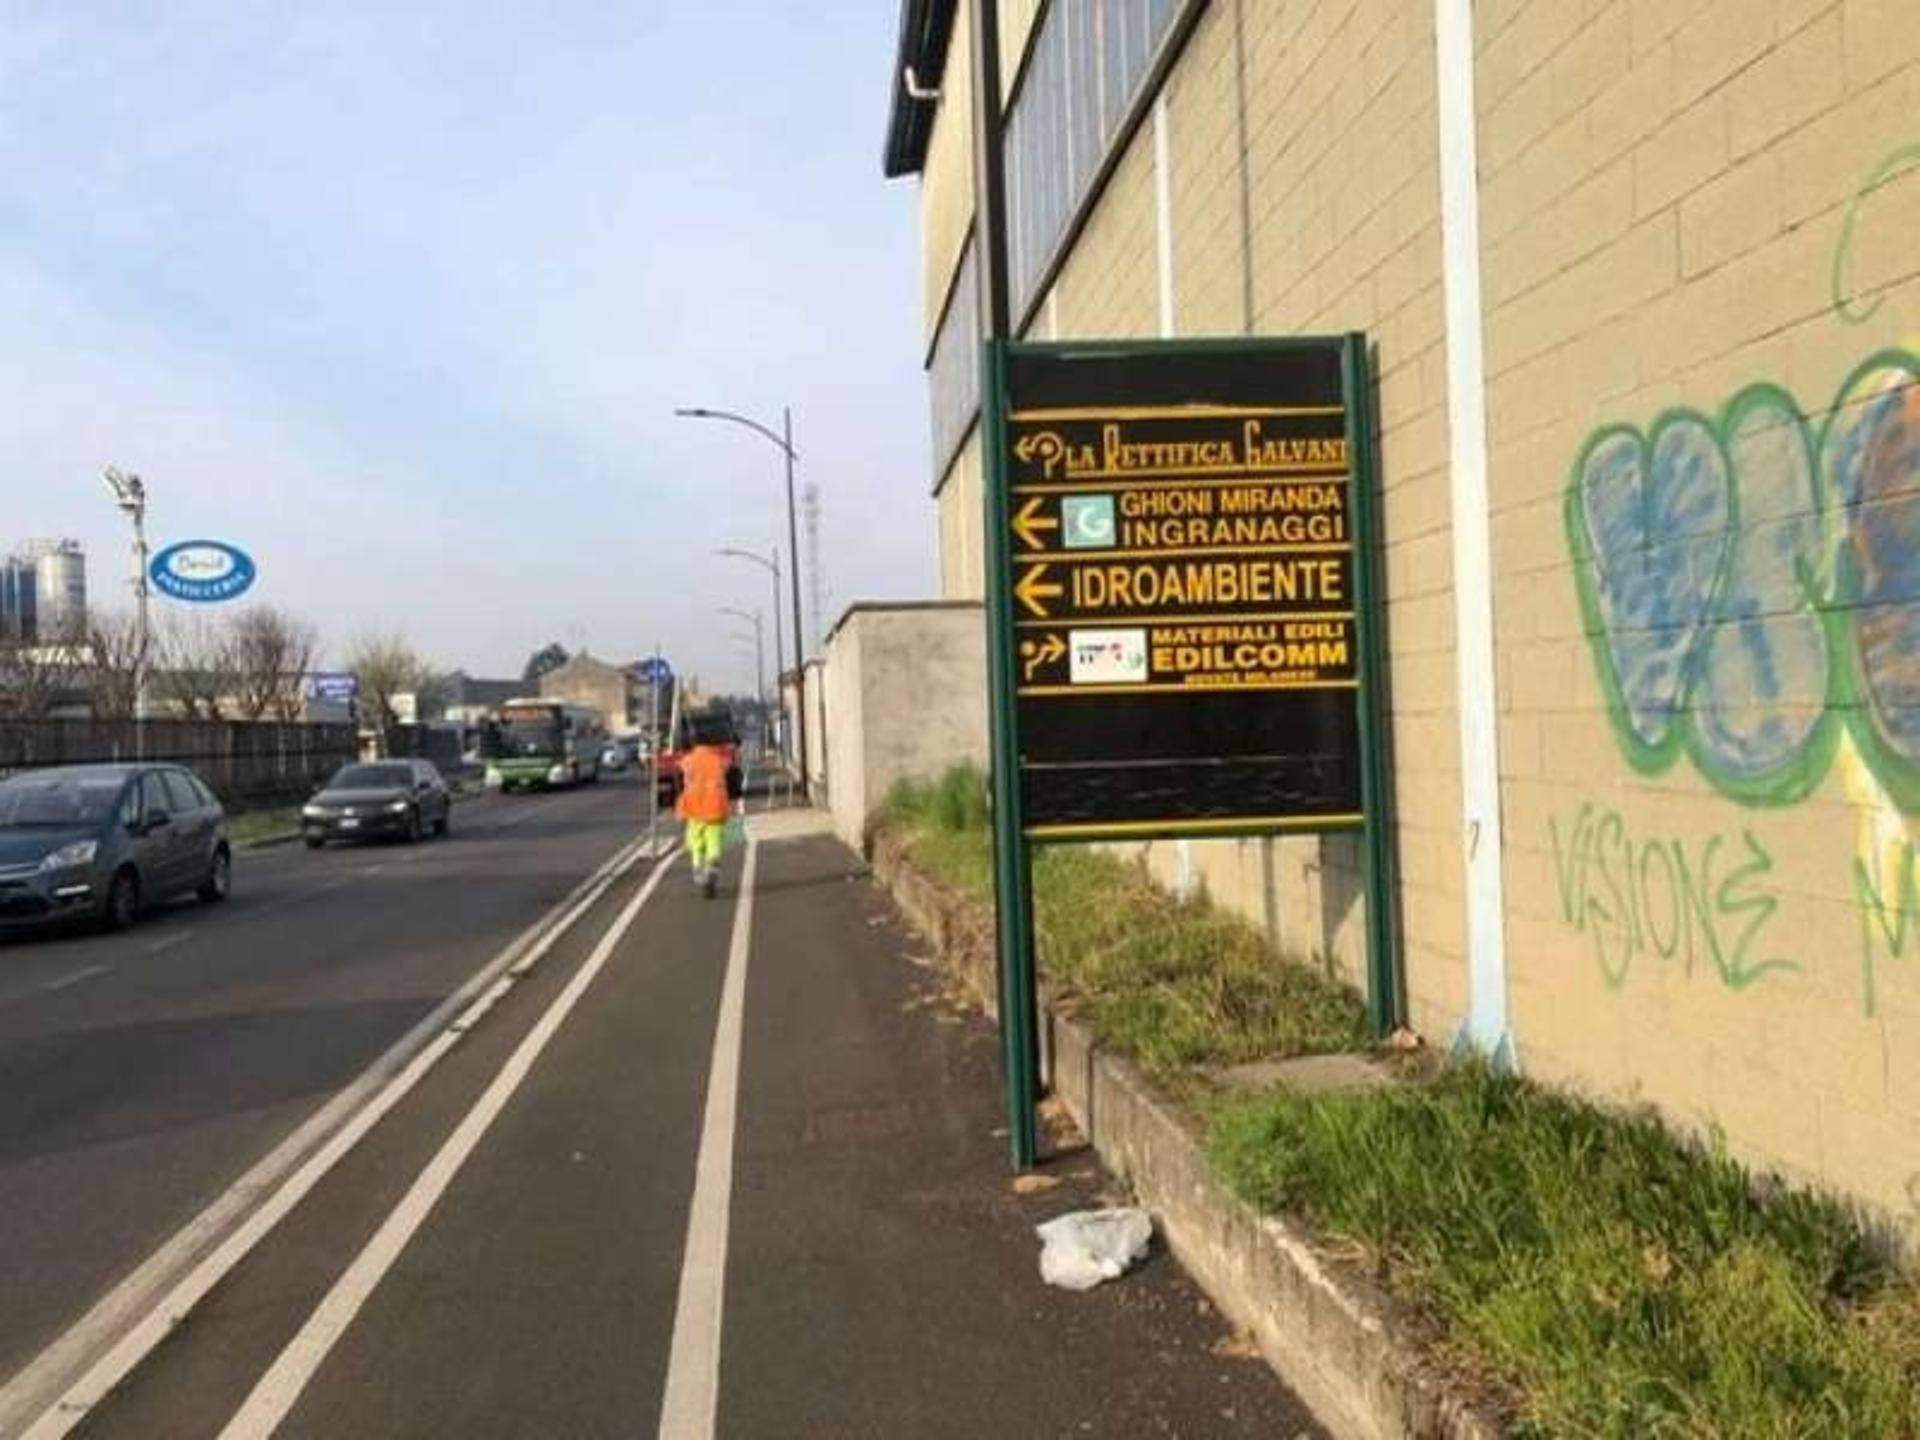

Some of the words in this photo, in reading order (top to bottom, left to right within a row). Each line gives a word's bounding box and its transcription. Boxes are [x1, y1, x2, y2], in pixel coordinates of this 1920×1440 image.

[1066, 447, 1095, 468] LA
[1120, 489, 1212, 517] GHIONI
[1221, 485, 1343, 513] MIRANDA
[1123, 515, 1343, 546] INGRANAGGI
[1072, 560, 1343, 608] IDROAMBIENTE
[1151, 625, 1276, 645] MATERIALI
[1284, 622, 1345, 640] EDILI
[1152, 642, 1347, 673] EDILCOMM
